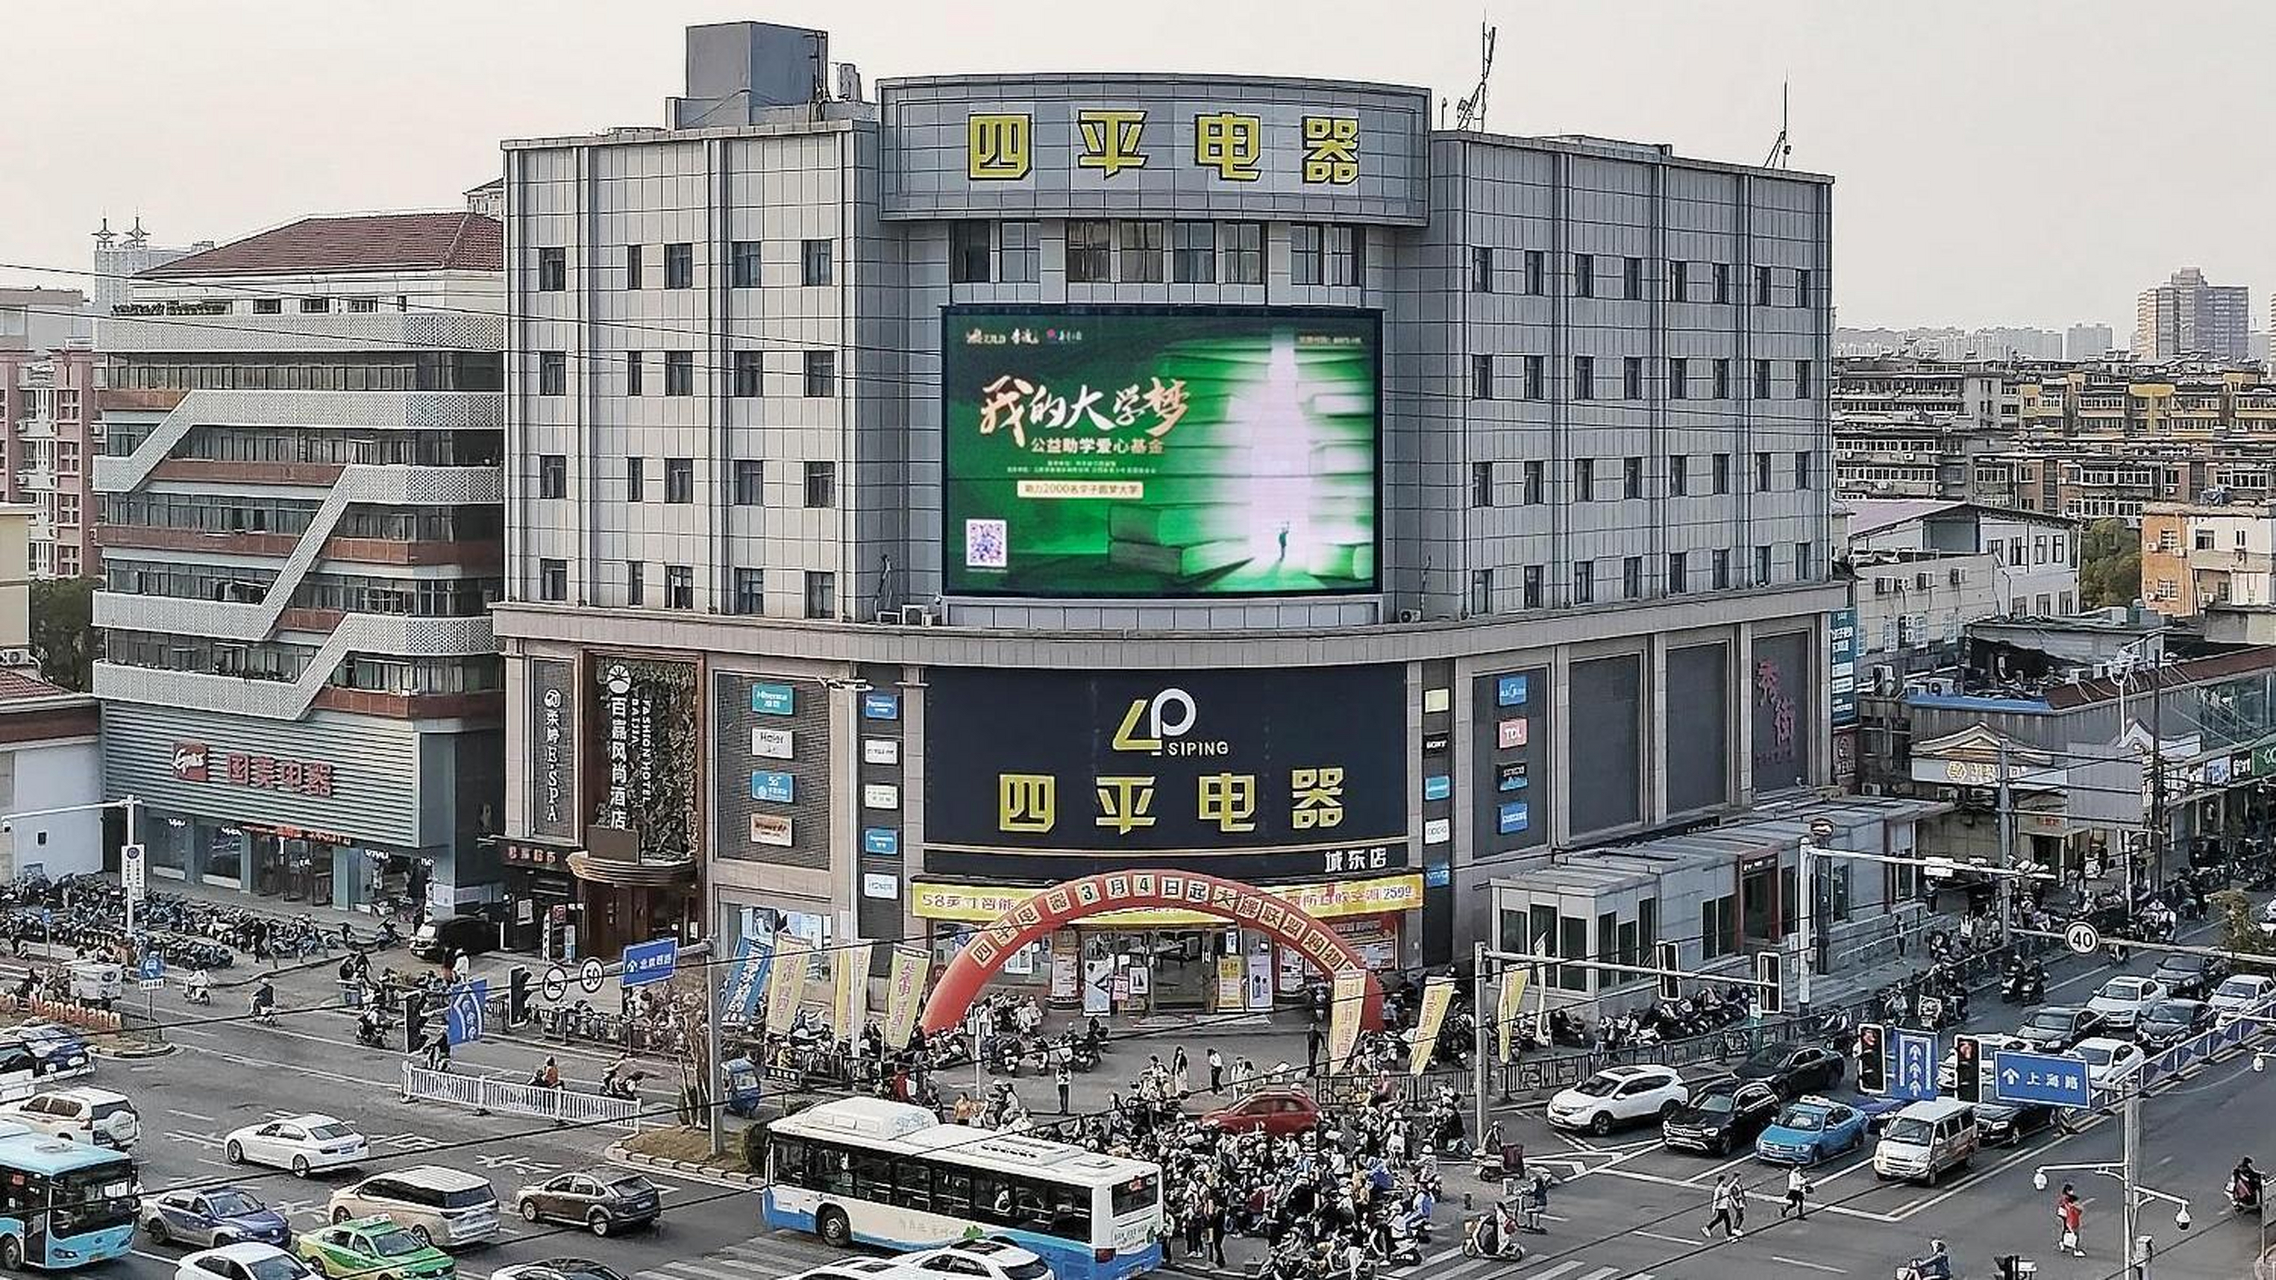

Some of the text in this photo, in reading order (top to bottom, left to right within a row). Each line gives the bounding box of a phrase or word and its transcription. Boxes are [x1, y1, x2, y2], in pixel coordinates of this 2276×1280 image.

[968, 110, 1360, 184] 四平电器
[980, 375, 1190, 448] 我的大学梦
[1031, 437, 1165, 454] 公益助学爱心基金
[610, 697, 628, 830] 百嘉风尚酒店
[1168, 741, 1229, 756] SIPING
[227, 752, 333, 798] 国美电器
[641, 761, 652, 803] HOTEL
[1000, 767, 1345, 834] 四平电器
[1325, 847, 1387, 872] 城东店
[2071, 930, 2094, 949] 40
[586, 966, 600, 986] 50
[29, 991, 122, 1030] Nanchang
[2026, 1072, 2079, 1090] 上海路
